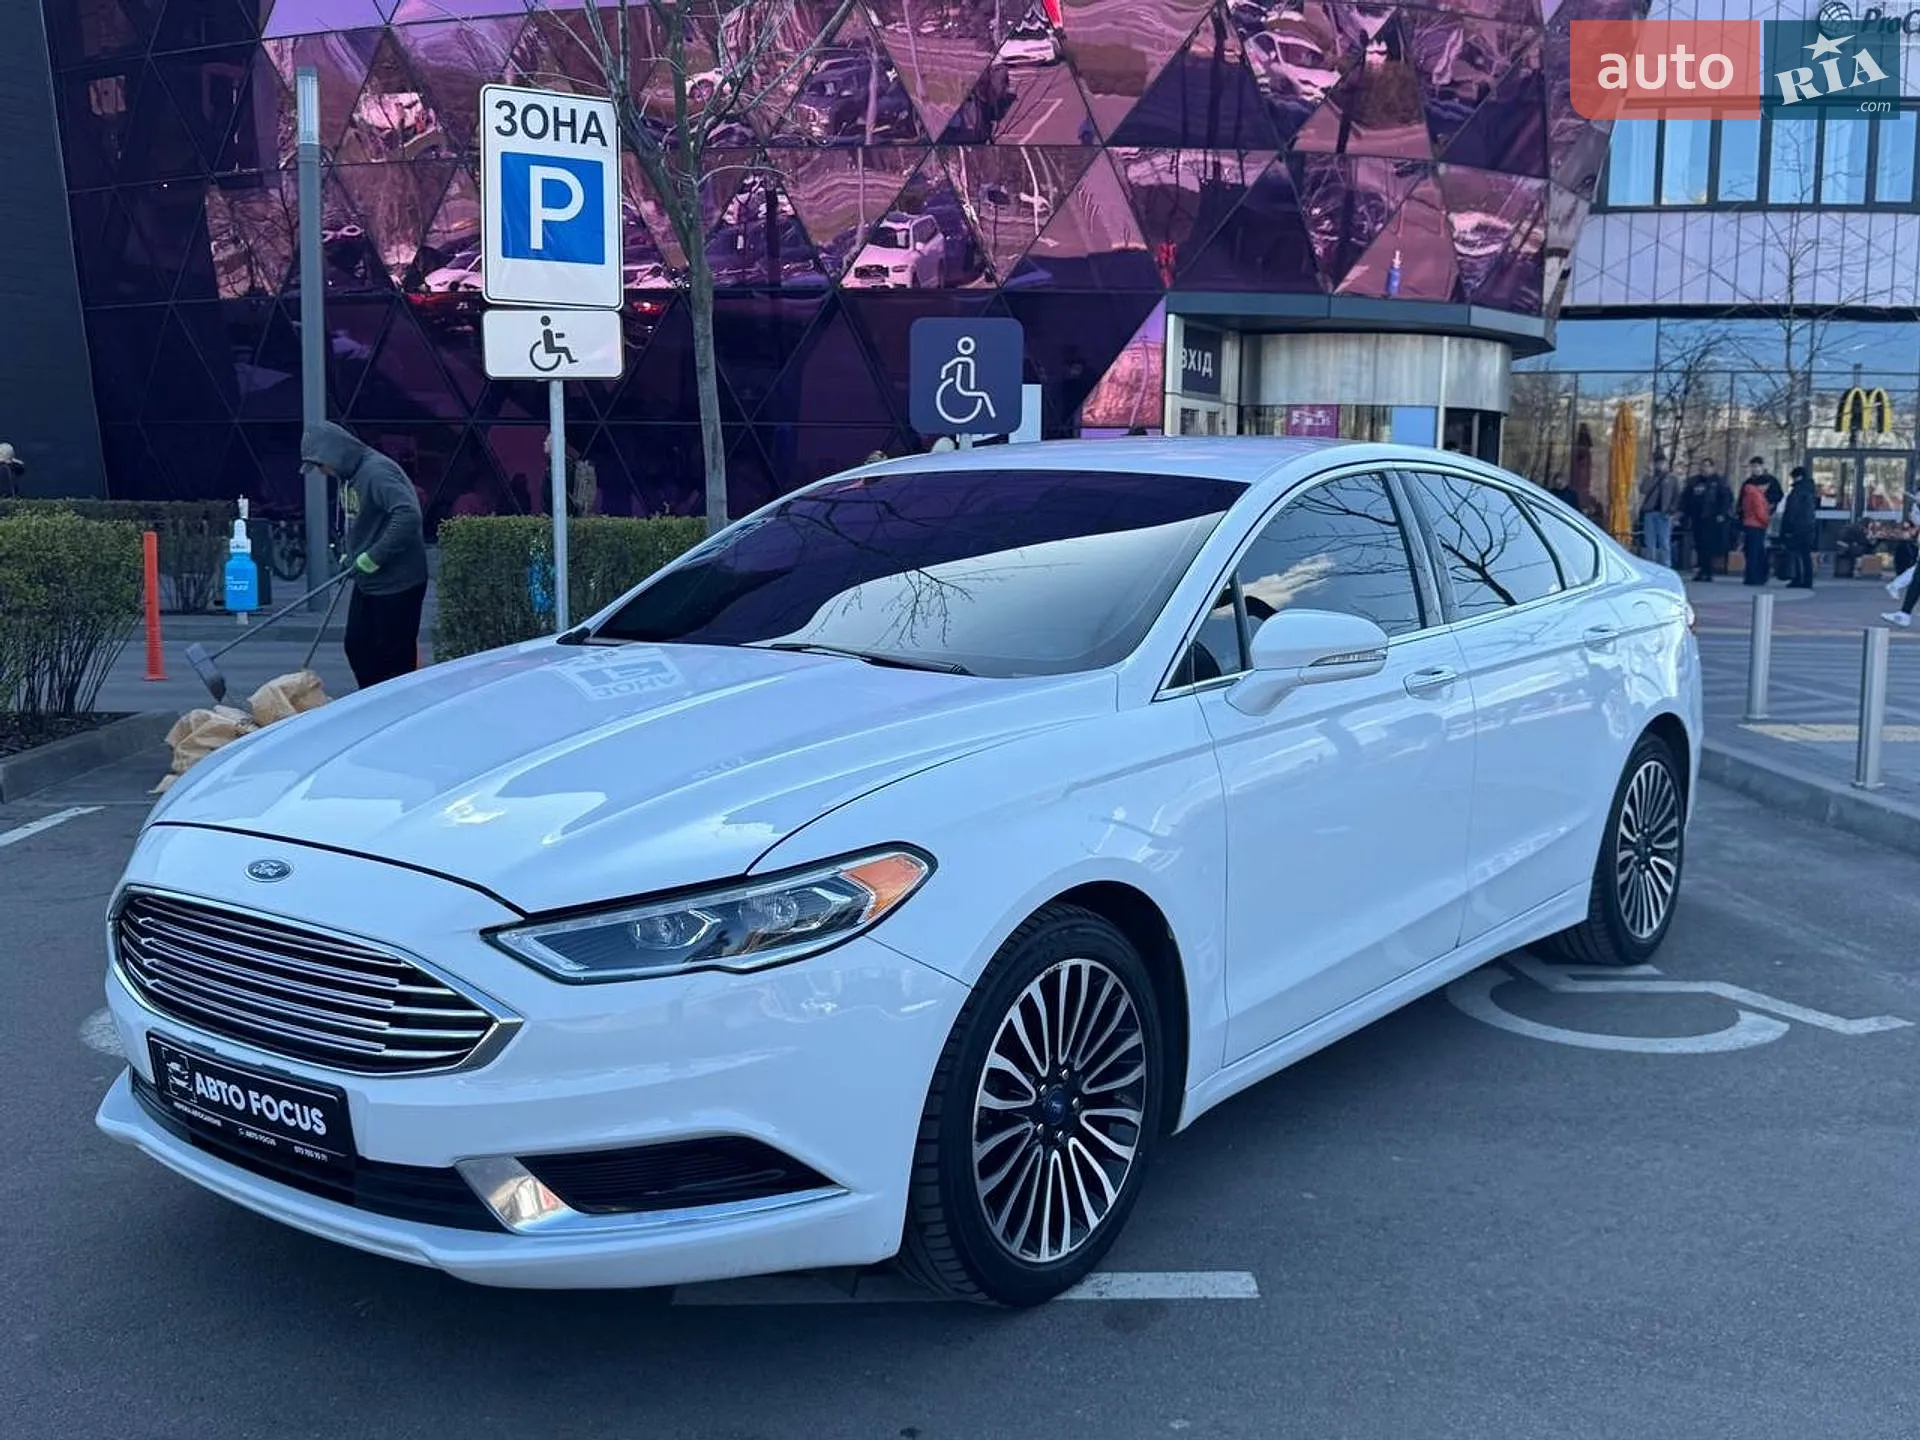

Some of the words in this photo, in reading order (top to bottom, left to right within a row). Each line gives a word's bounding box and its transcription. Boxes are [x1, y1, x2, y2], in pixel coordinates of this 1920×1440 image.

[495, 100, 608, 147] ЗОНА
[530, 165, 584, 249] P
[195, 1072, 246, 1111] АВТО
[248, 1090, 327, 1136] FOCUS
